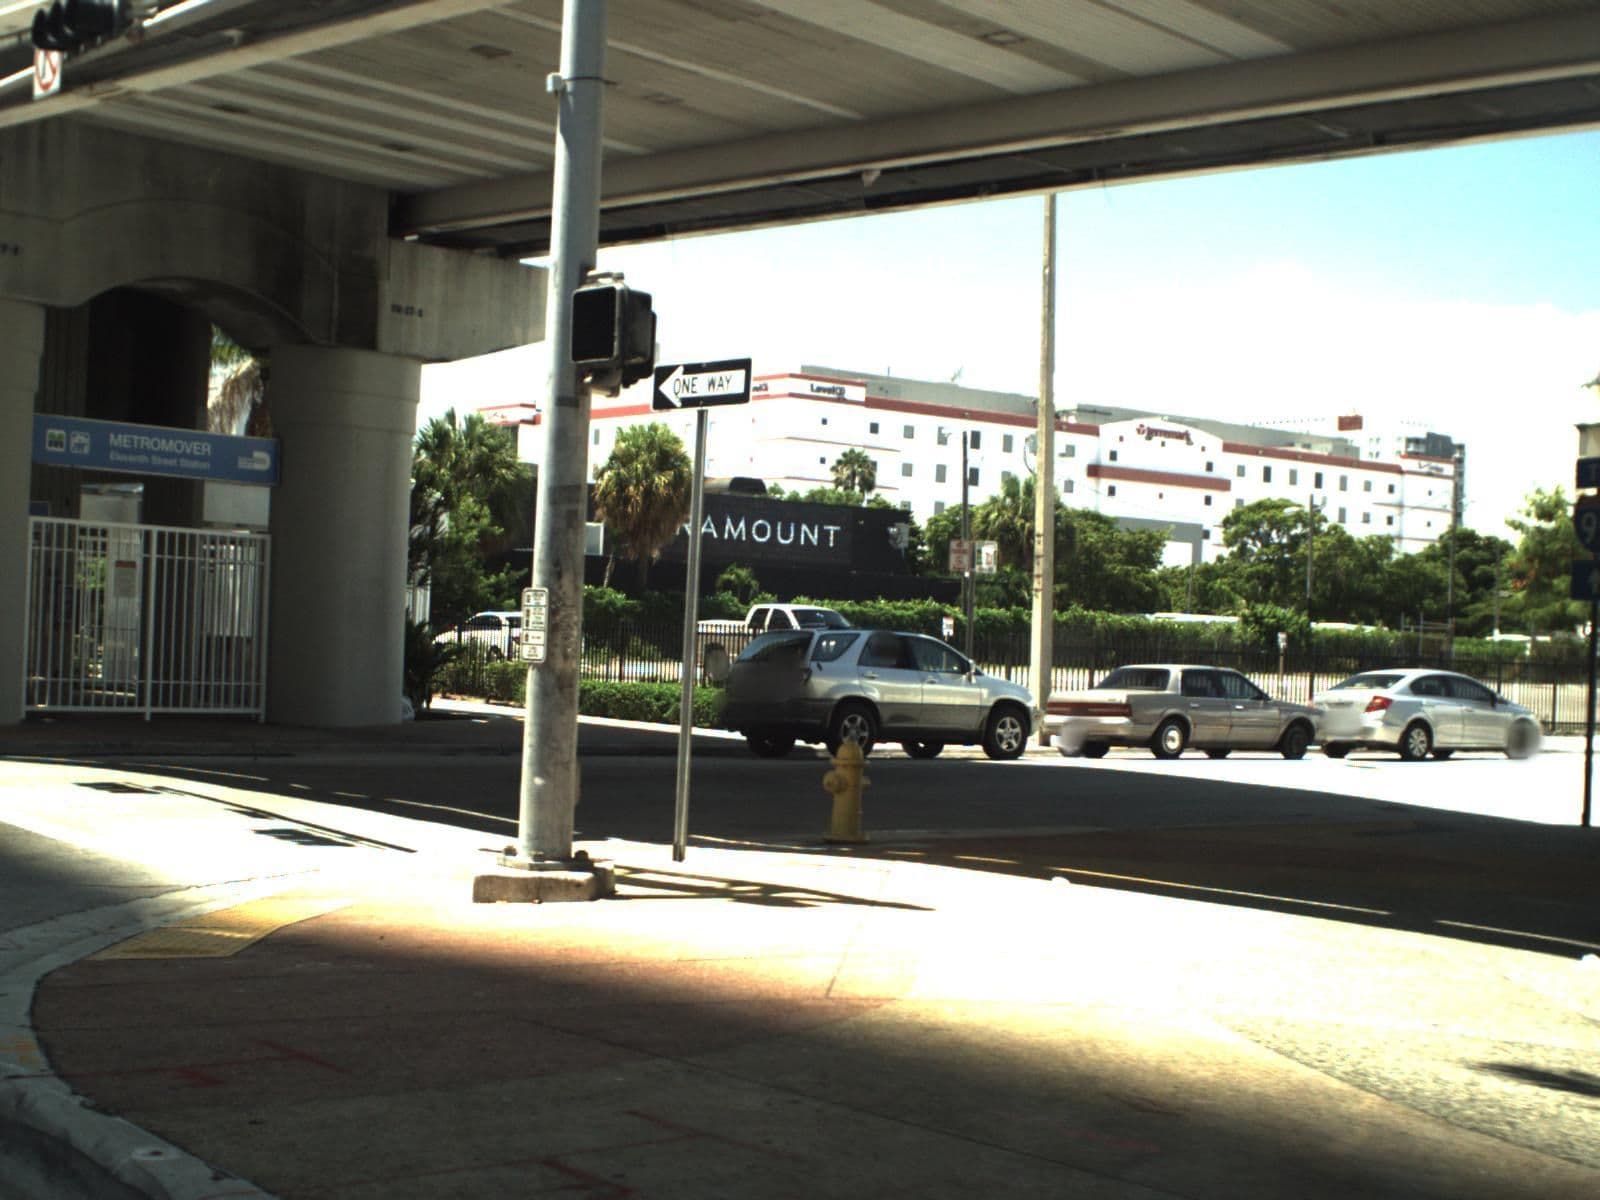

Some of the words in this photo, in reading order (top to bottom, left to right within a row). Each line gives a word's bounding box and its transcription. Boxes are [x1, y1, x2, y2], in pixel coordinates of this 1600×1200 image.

[673, 377, 698, 396] ONE
[707, 374, 733, 392] WAY
[109, 432, 211, 456] METROMOVER
